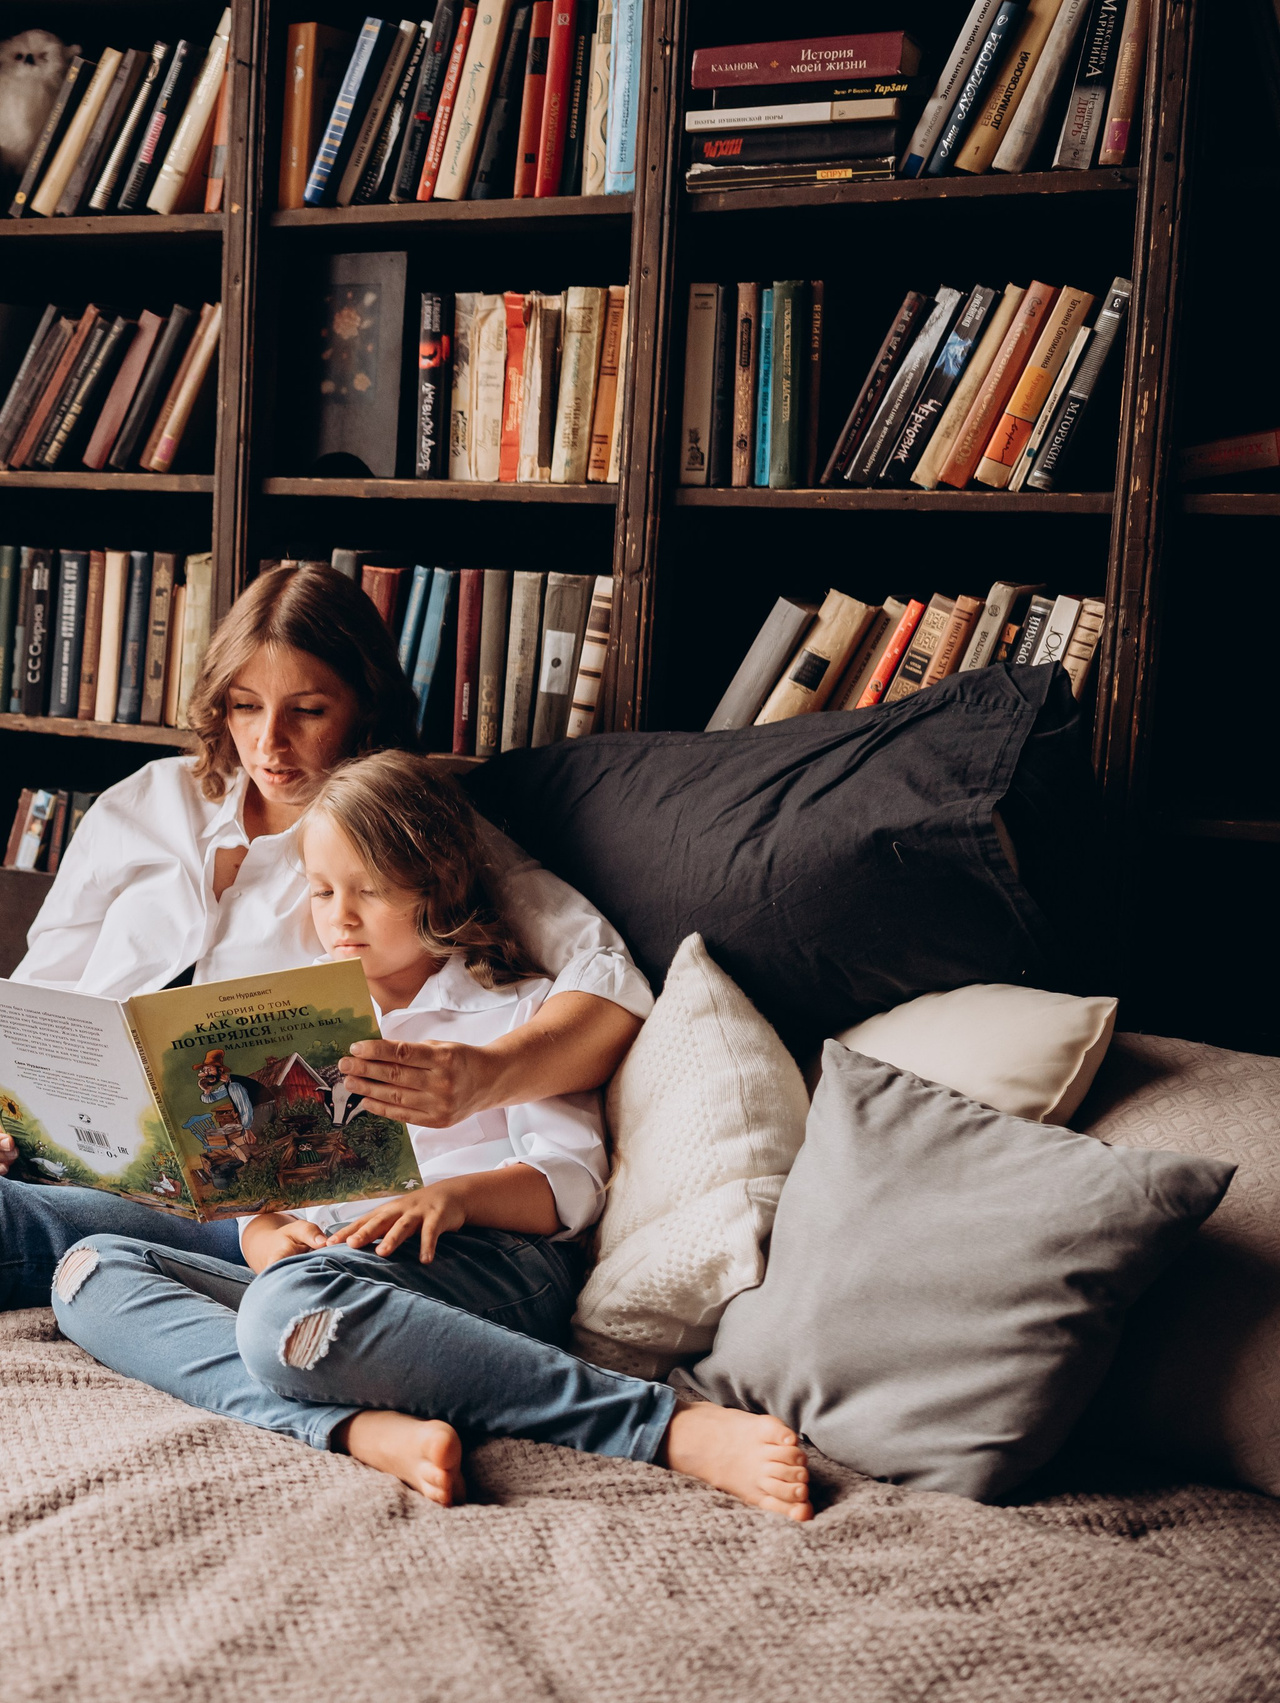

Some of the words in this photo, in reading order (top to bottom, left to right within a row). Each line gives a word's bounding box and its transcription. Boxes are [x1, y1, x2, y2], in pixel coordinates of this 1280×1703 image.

[410, 33, 427, 66] STAR
[801, 49, 854, 61] История
[1098, 13, 1115, 65] АЛЕКСАНДРА
[711, 62, 759, 73] КАЗАНОВА
[790, 61, 822, 74] моей
[825, 59, 867, 71] жизни
[940, 55, 965, 100] Элементы
[961, 23, 980, 55] теории
[397, 64, 415, 97] WARS
[936, 122, 960, 158] Анна
[953, 29, 1002, 121] АХМАТОВА
[989, 49, 1031, 130] ДОЛМАТОВСКИЙ
[718, 115, 762, 124] ПУШКИНСКОЙ
[764, 114, 784, 122] ПОРЫ
[1069, 96, 1089, 137] ДВЕРЬ
[1078, 91, 1099, 146] Незапертая
[820, 170, 849, 178] СПРУТ
[960, 293, 983, 328] ЛУКЬЯНЕНКО
[1060, 296, 1080, 327] Татьяна
[1039, 324, 1065, 370] Соломатина
[781, 378, 789, 422] МАСТЕРА
[861, 425, 889, 475] Американская
[884, 371, 914, 426] фантастическая
[1042, 401, 1080, 471] М.ГОРЬКИЙ
[936, 621, 963, 677] А.К.ТОЛСТОЙ
[968, 629, 989, 669] ТОЛСТОЙ
[1014, 614, 1041, 666] ОРЬКИЙ
[206, 1005, 254, 1020] ИСТОРИЯ
[268, 1000, 291, 1009] ТОМ
[218, 995, 235, 1003] Свен
[236, 989, 272, 1000] Нурдквист
[194, 1019, 231, 1034] КАК
[236, 1006, 310, 1026] ФИНДУС
[280, 1022, 315, 1033] КОГДА
[319, 1017, 342, 1027] БЫЛ
[224, 1033, 294, 1051] МАЛЕНЬКИЙ
